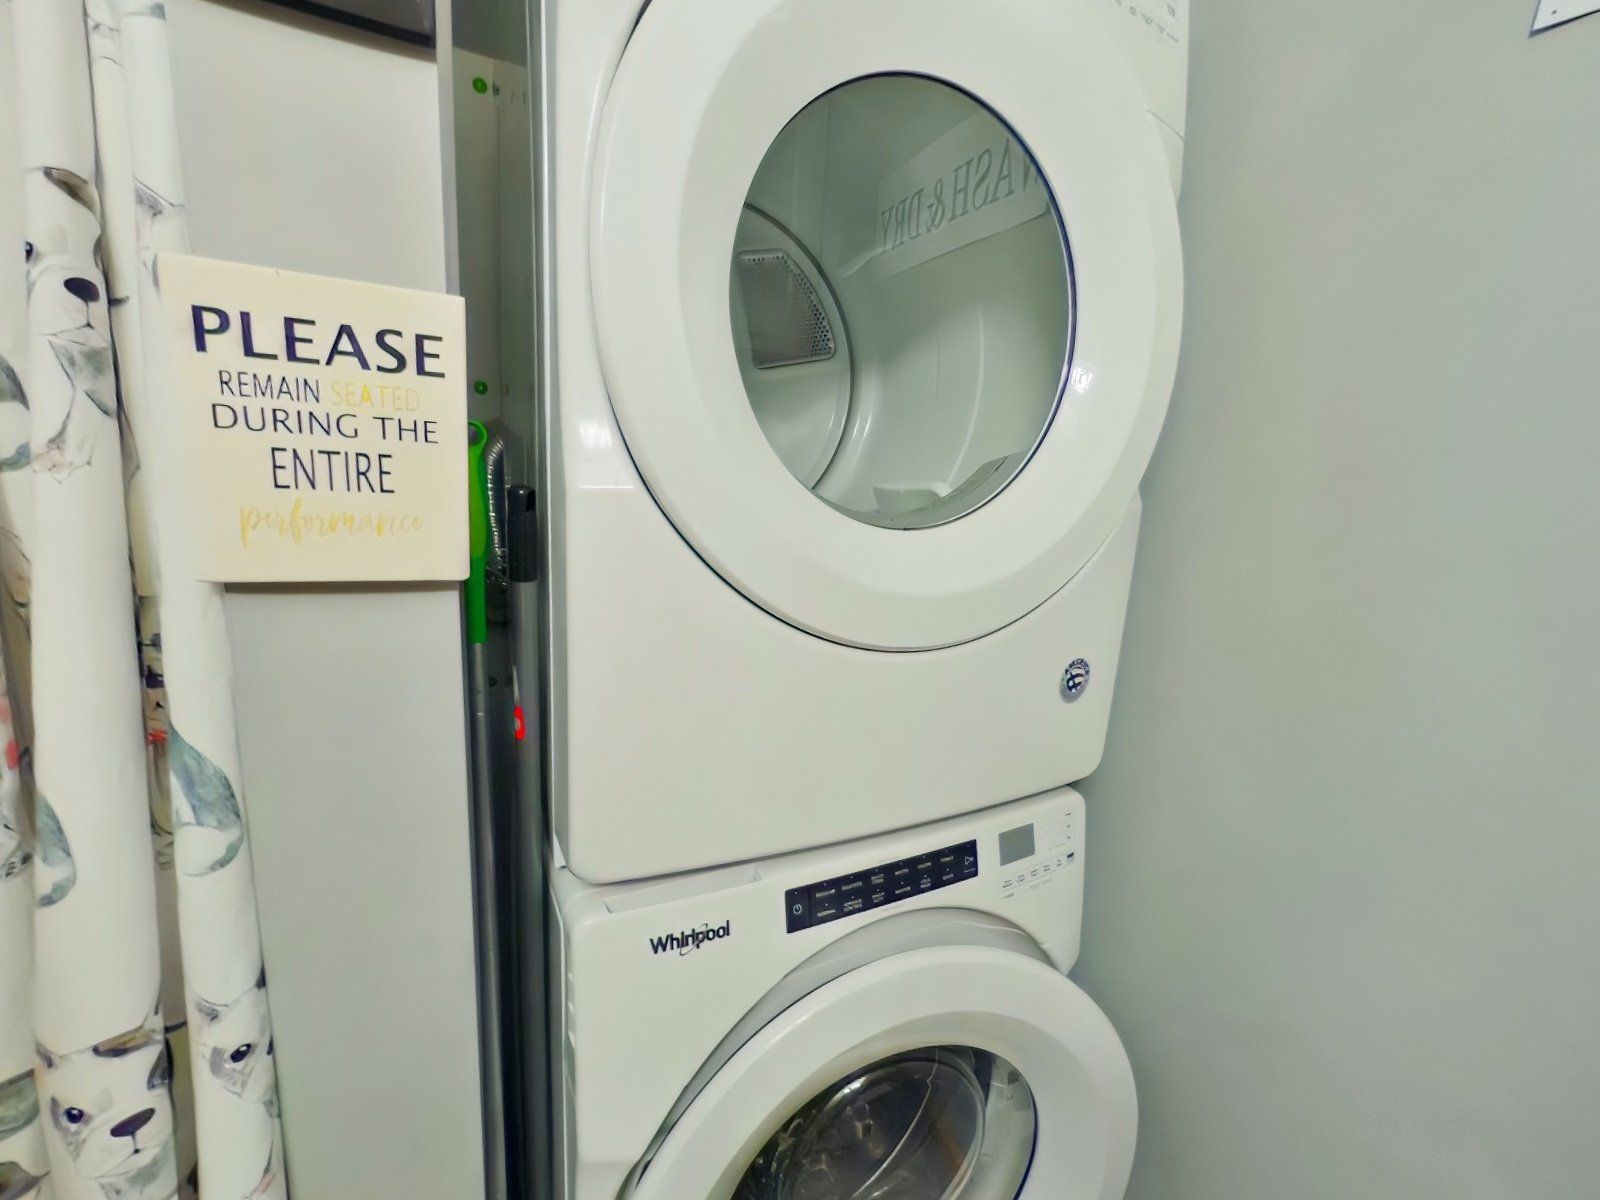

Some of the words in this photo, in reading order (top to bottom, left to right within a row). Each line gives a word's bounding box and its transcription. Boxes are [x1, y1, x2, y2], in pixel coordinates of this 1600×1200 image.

[191, 304, 446, 378] PLEASE
[218, 370, 321, 403] REMAIN
[330, 380, 421, 412] SEATED
[211, 403, 359, 439] DURING
[372, 416, 439, 444] THE
[270, 446, 396, 494] ENTIRE
[238, 497, 424, 548] performance
[649, 919, 731, 955] Whirlpool
